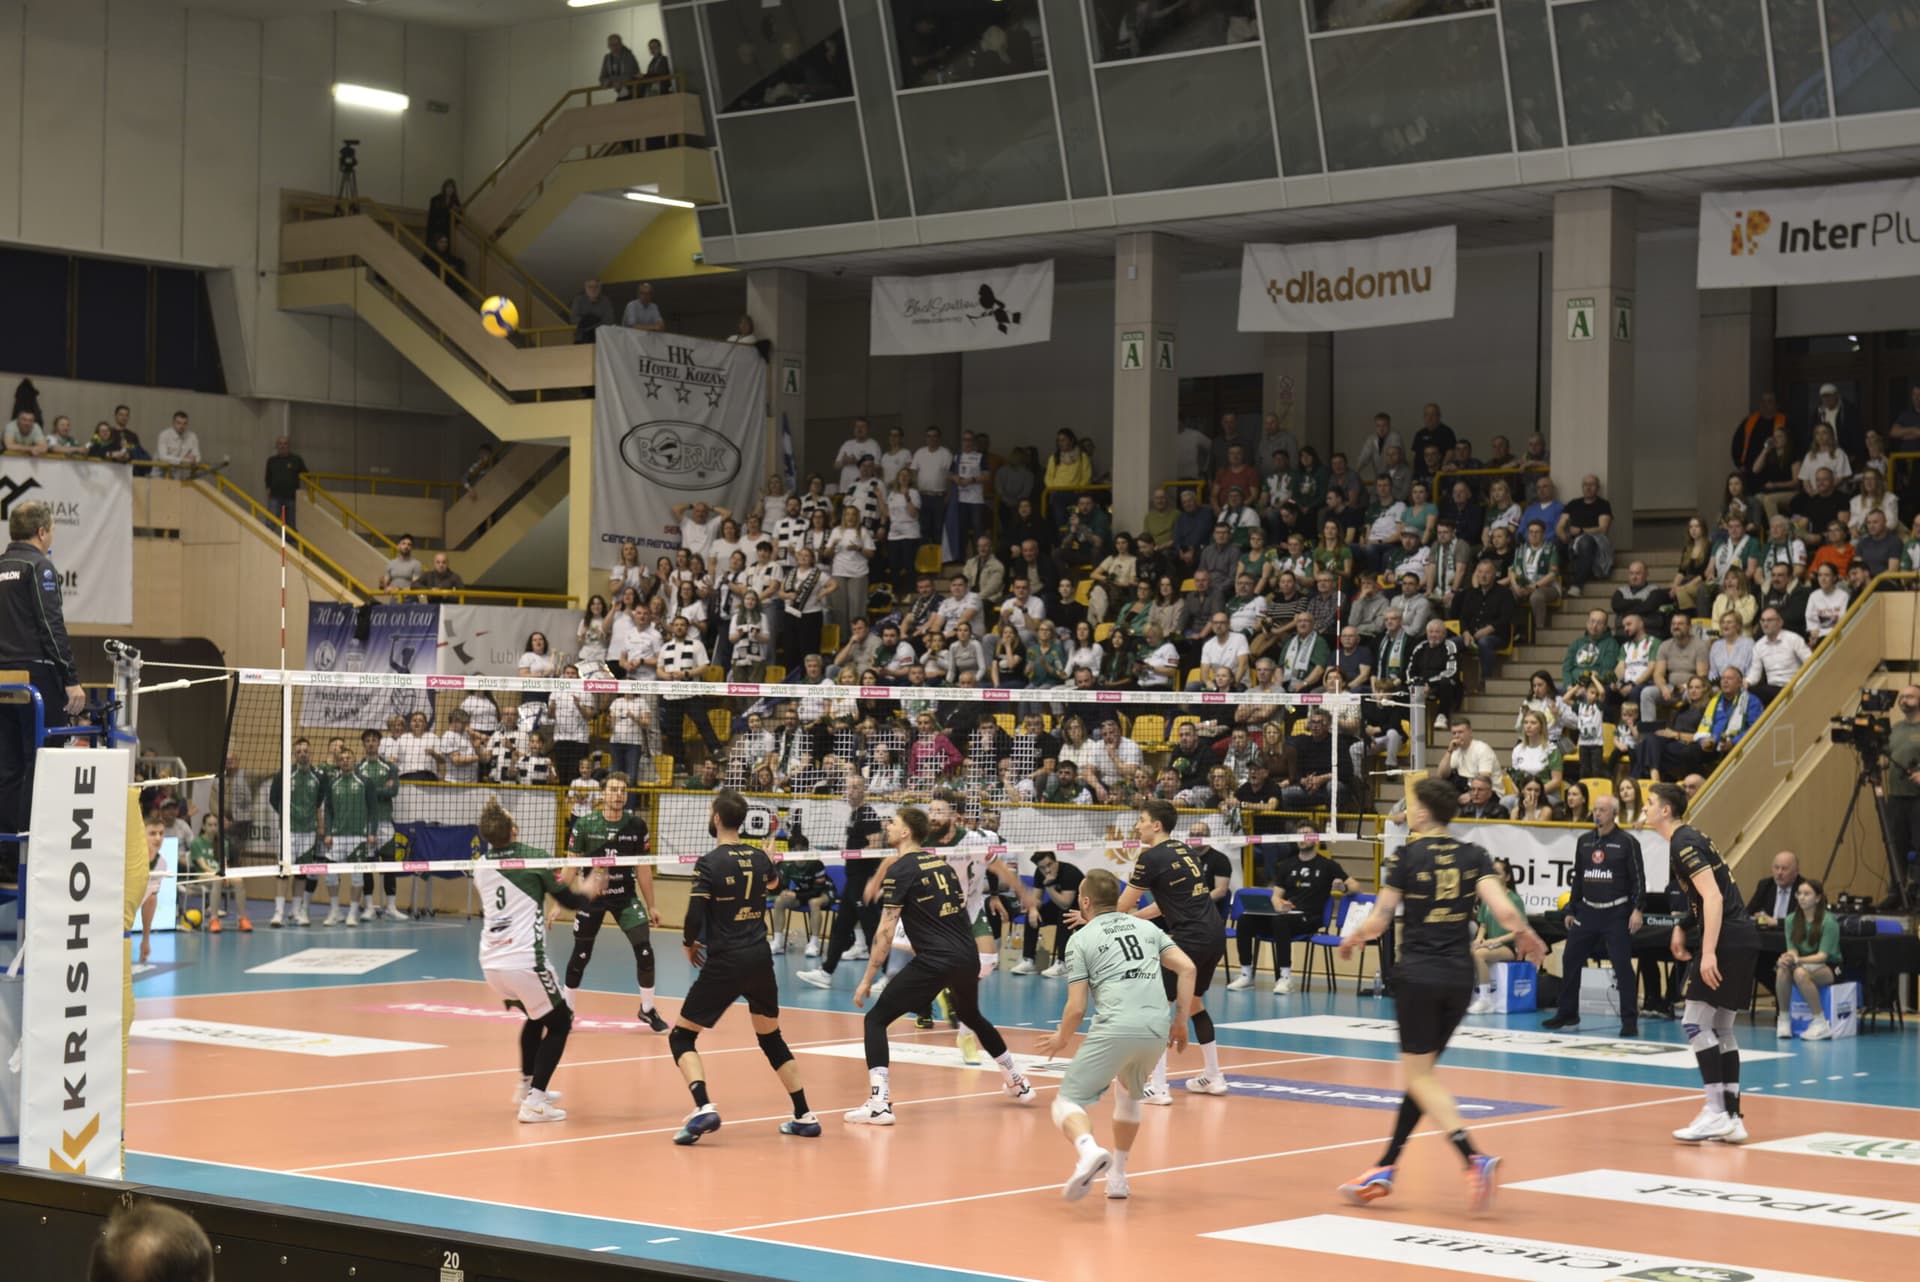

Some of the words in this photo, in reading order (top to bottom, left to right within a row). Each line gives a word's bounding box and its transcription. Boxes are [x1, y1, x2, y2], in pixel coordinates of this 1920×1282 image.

[1571, 310, 1590, 337] A
[1617, 310, 1628, 337] A
[668, 345, 695, 366] HK
[1124, 343, 1140, 368] A
[1160, 343, 1171, 368] A
[785, 370, 797, 392] A
[1183, 856, 1201, 877] 5
[742, 871, 753, 900] 7
[934, 871, 950, 895] 4
[496, 886, 506, 910] 9
[63, 765, 97, 1111] KRISHOME
[1114, 934, 1144, 961] 18
[443, 1250, 460, 1269] 20
